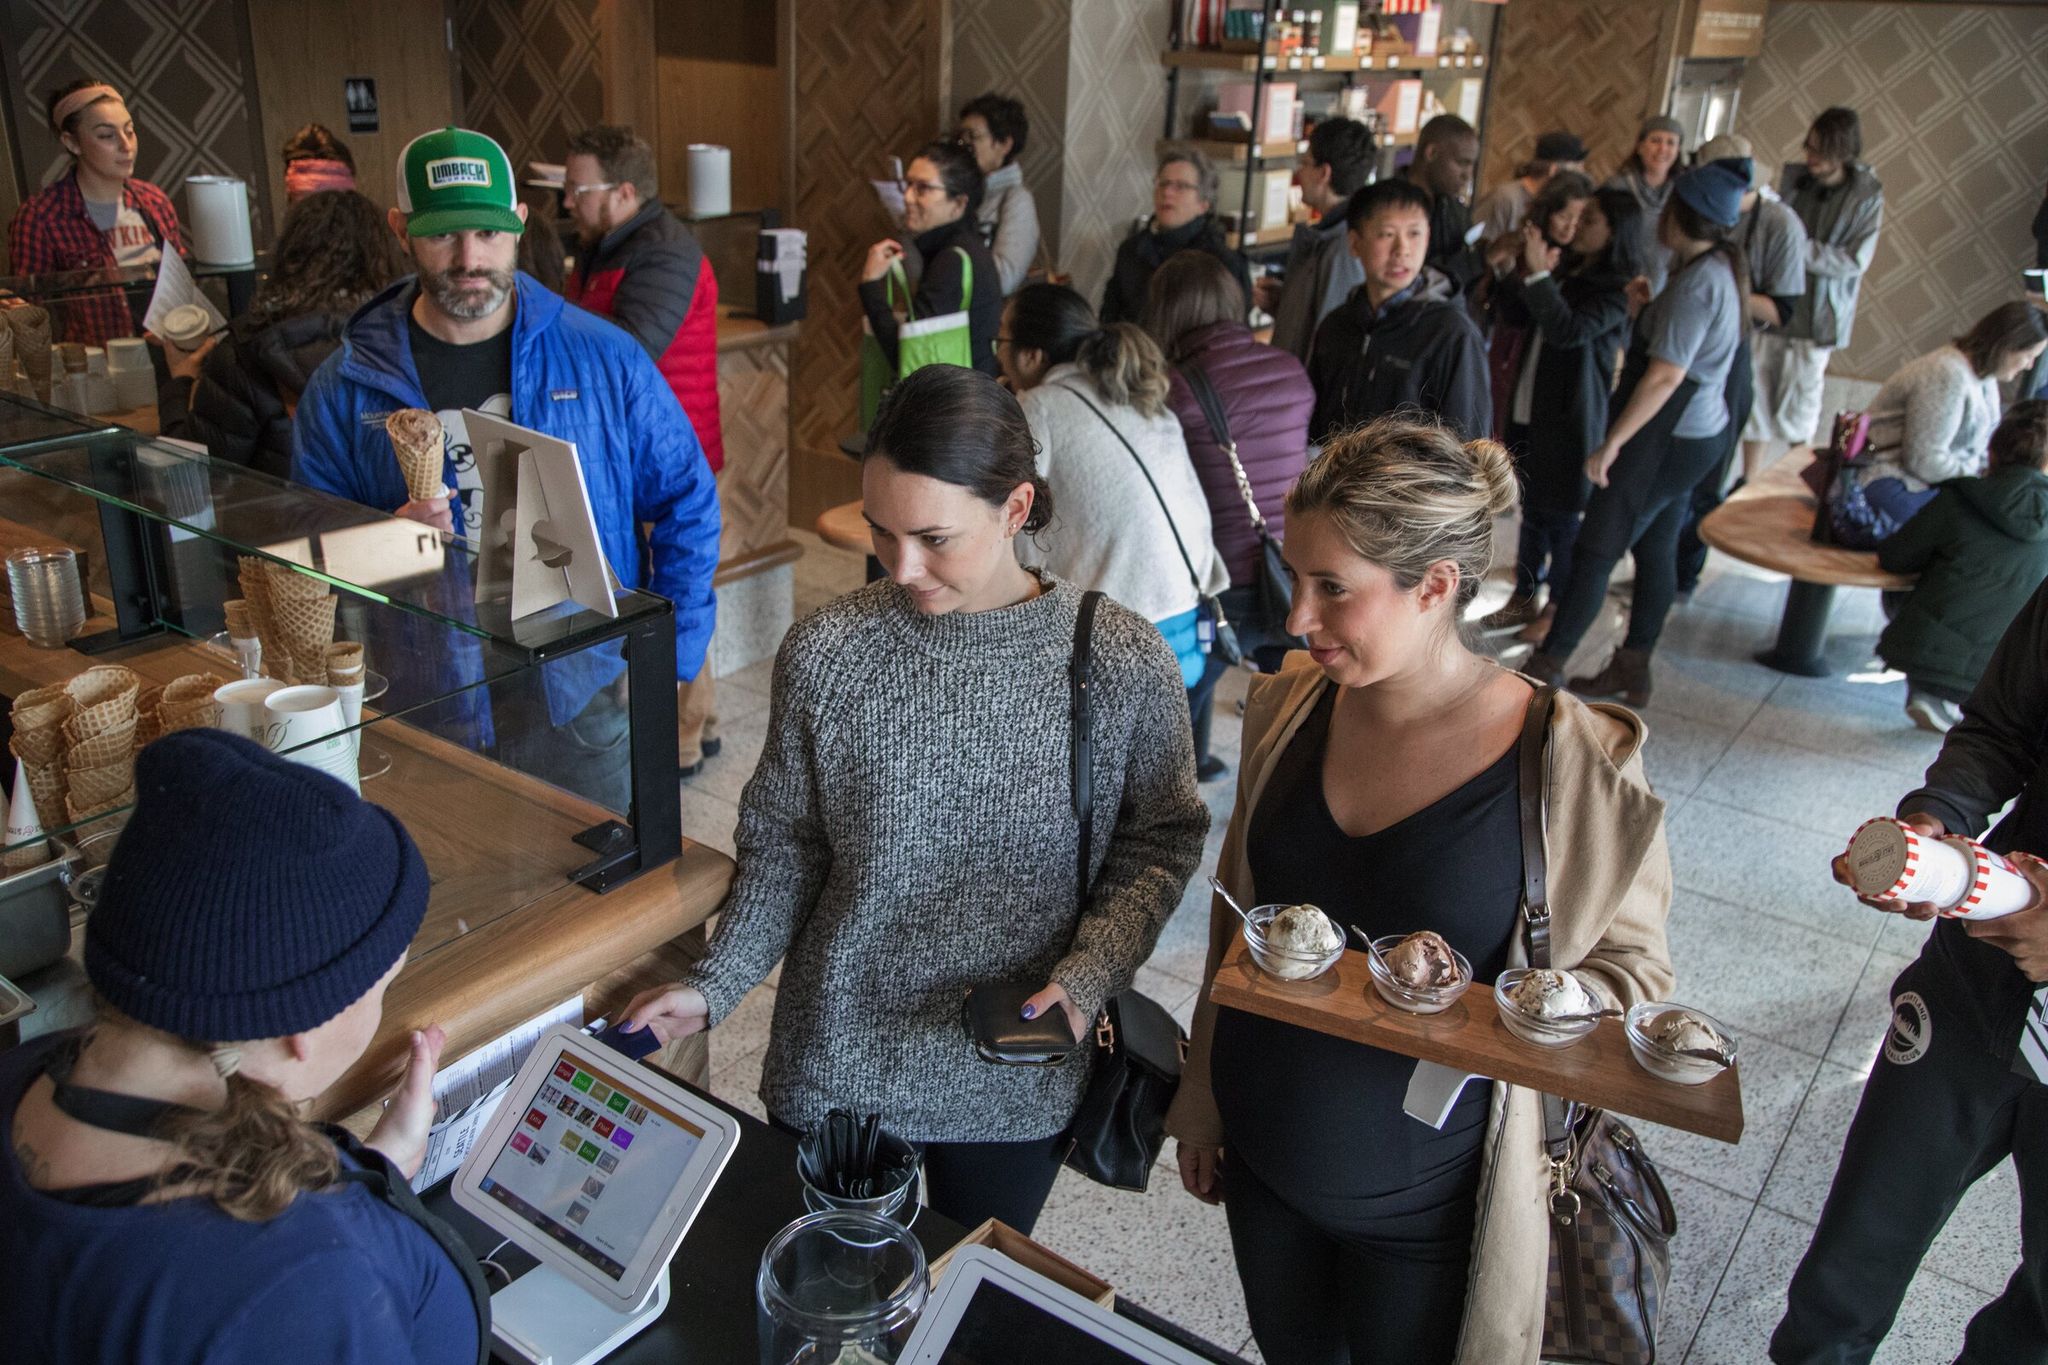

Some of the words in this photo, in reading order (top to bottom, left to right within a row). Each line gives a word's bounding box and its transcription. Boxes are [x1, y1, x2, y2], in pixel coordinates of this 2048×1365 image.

[1902, 993, 1928, 1021] PORTLAND
[1901, 1048, 1921, 1062] CLUB
[453, 1126, 470, 1158] SEATTLE
